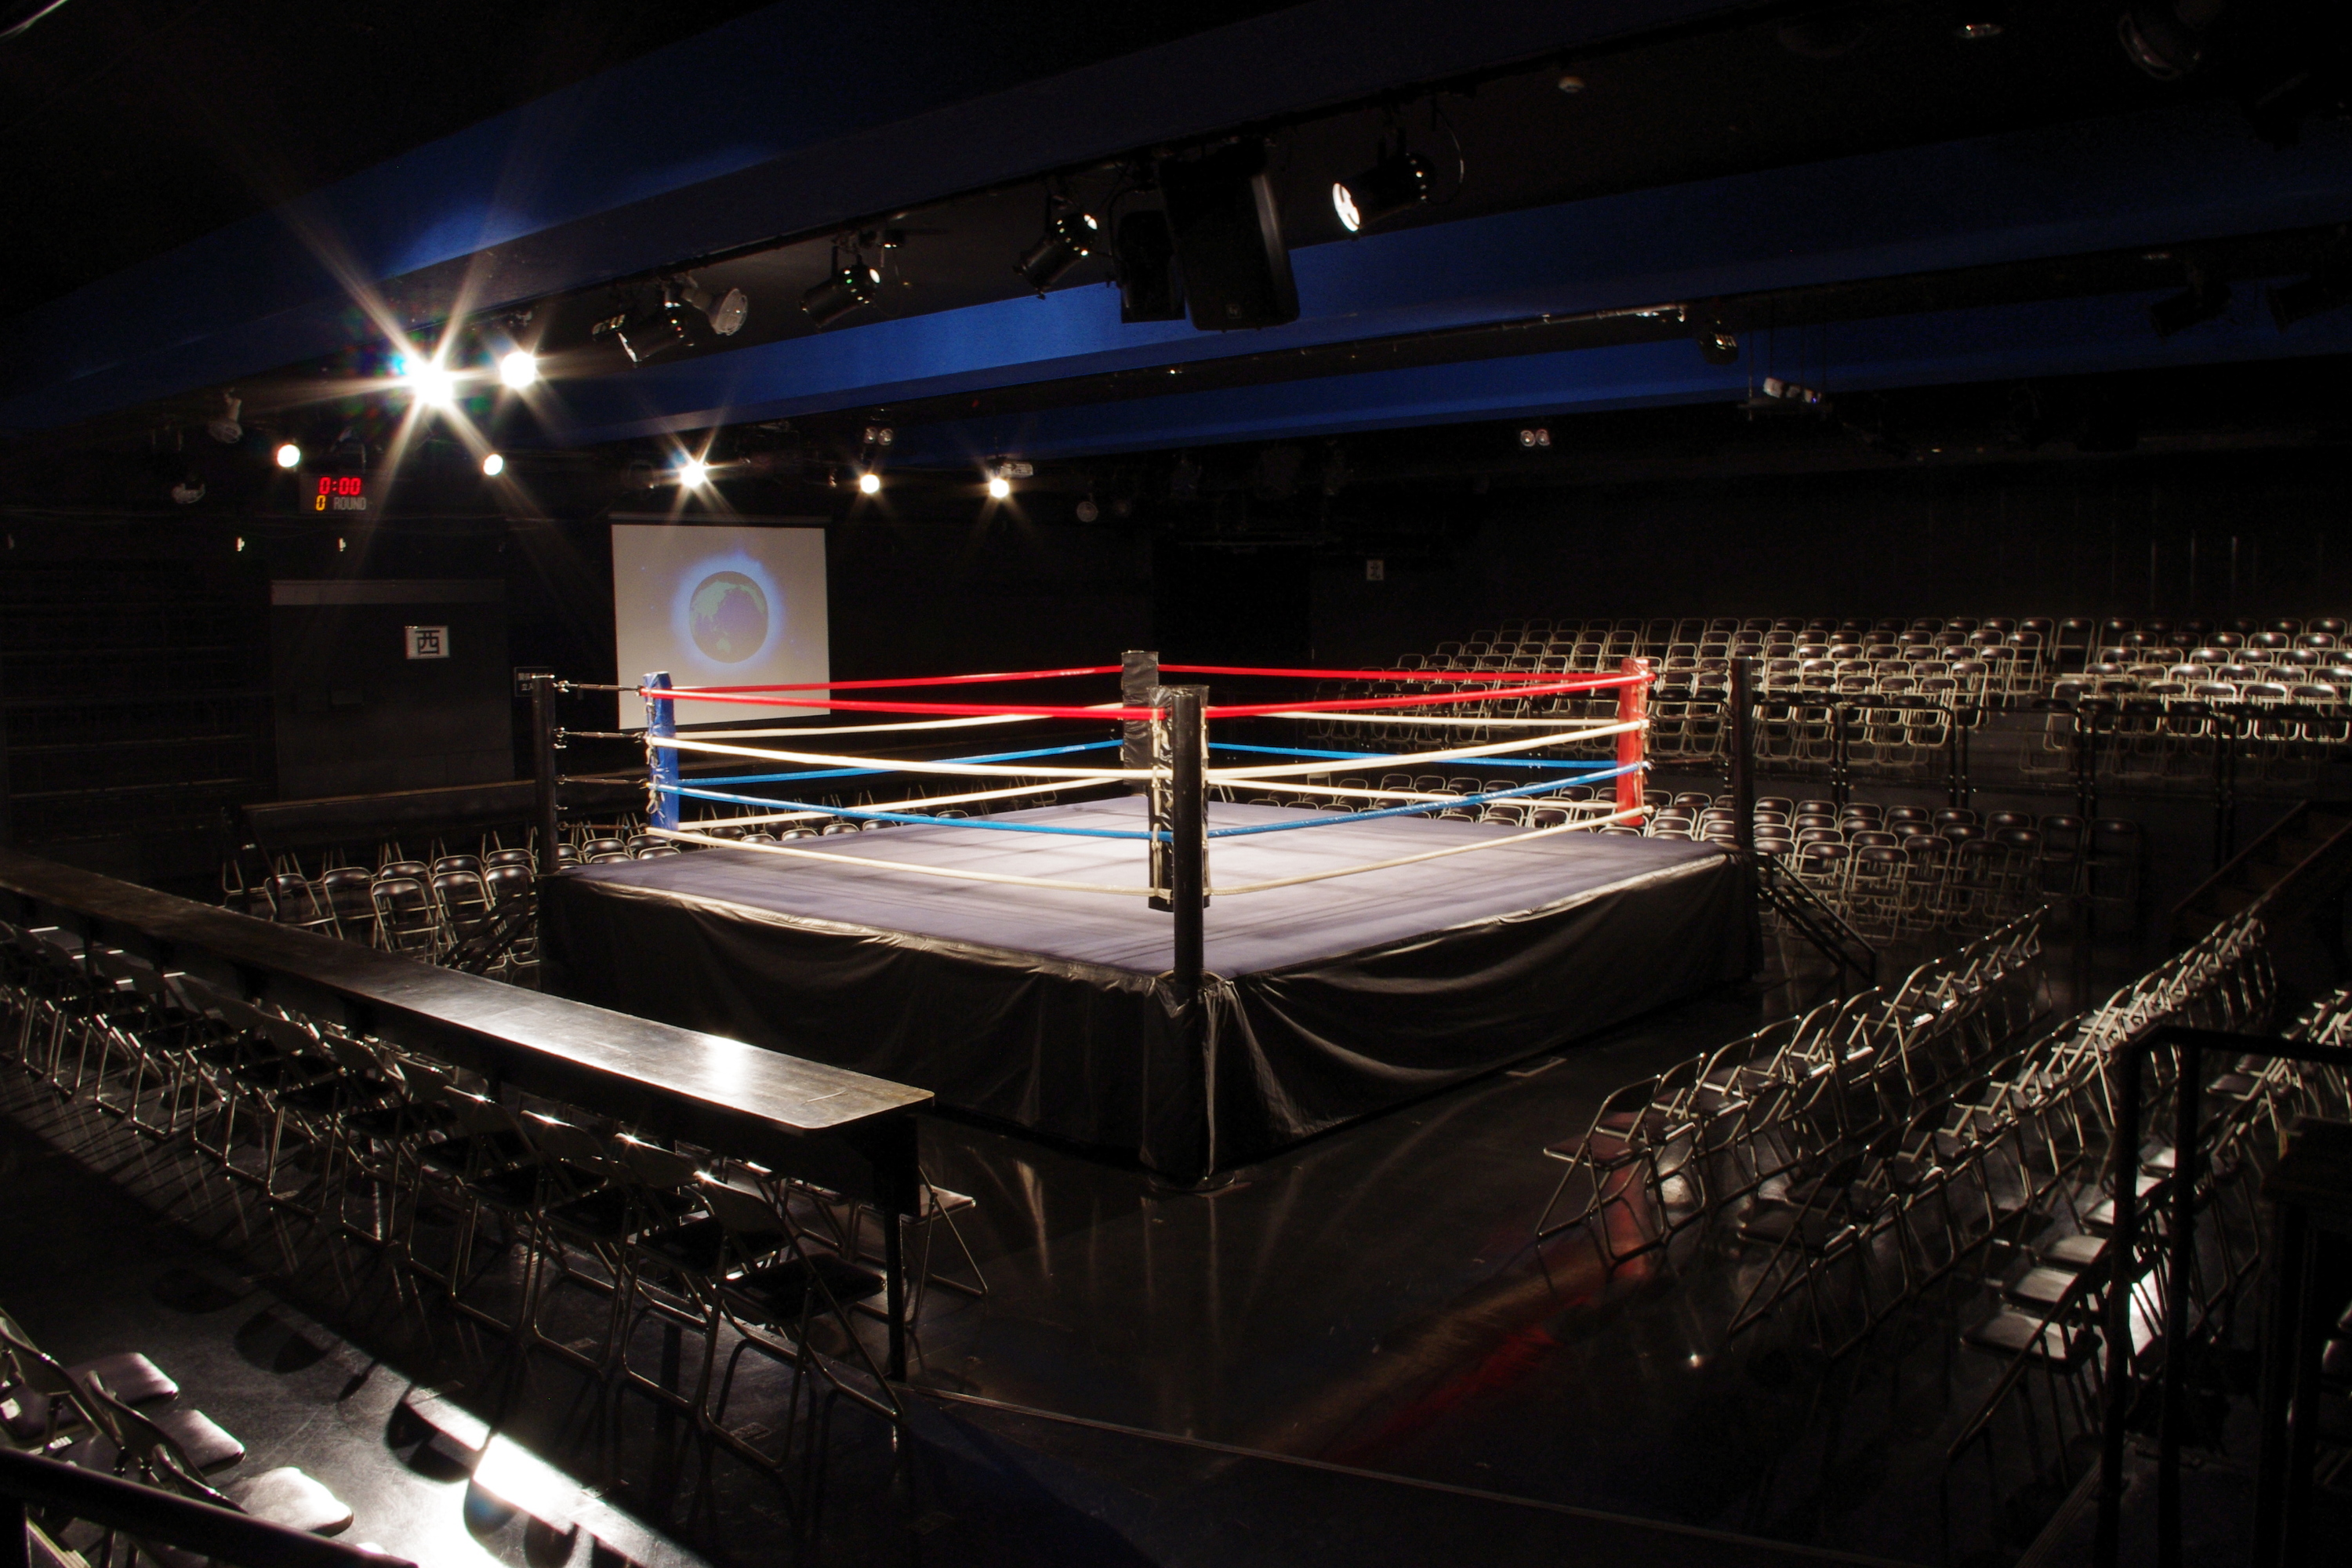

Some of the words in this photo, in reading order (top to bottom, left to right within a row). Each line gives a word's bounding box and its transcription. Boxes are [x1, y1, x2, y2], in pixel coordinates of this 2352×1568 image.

[318, 476, 361, 495] 0:00
[315, 495, 326, 511] 0
[333, 496, 367, 510] ROUND
[415, 630, 441, 655] 西
